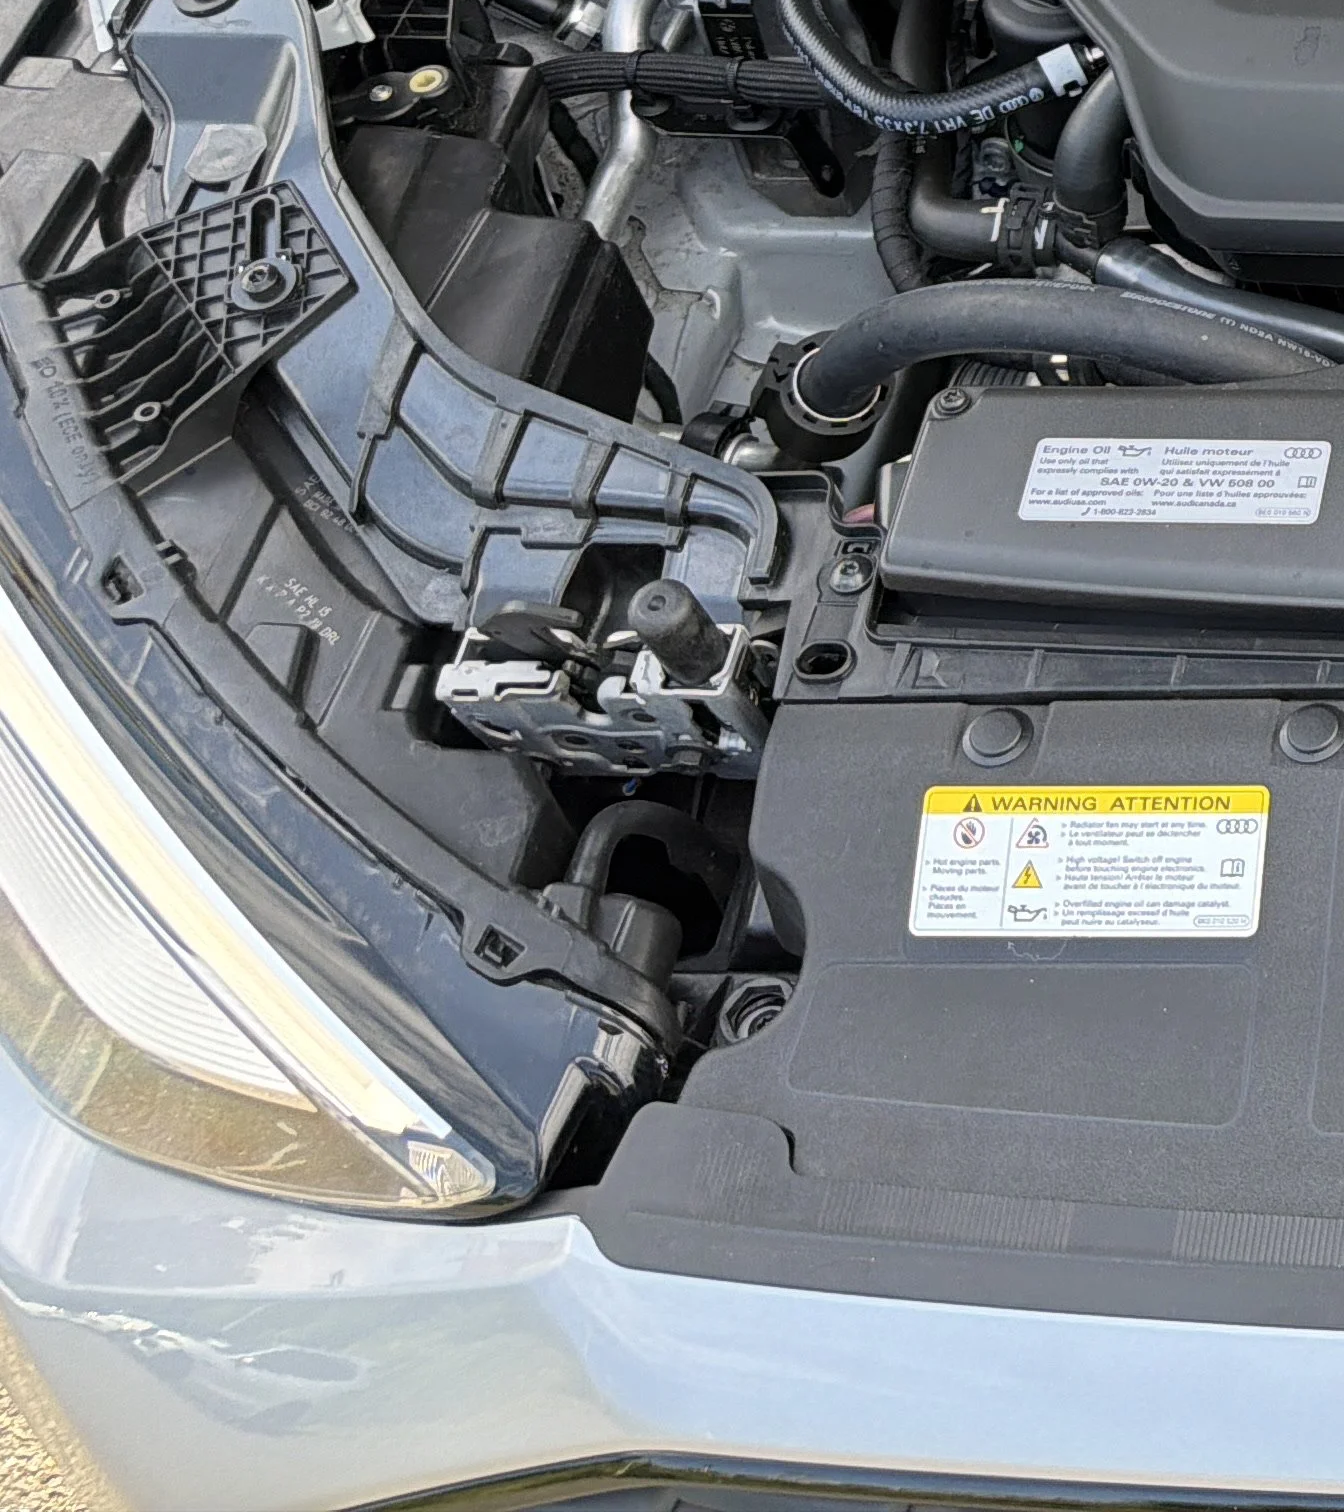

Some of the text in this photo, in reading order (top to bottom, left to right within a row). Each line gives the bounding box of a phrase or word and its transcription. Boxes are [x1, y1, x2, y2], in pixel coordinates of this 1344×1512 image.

[934, 105, 995, 134] DE VRT
[1043, 445, 1111, 456] Engine Oil
[1164, 446, 1253, 456] Huile moteur
[1058, 458, 1076, 466] only
[1196, 459, 1249, 468] uniquement
[1250, 459, 1262, 467] de
[1080, 468, 1118, 476] complies
[1120, 467, 1139, 475] with
[1159, 469, 1175, 477] qui
[1100, 477, 1129, 487] SAE
[1133, 478, 1179, 487] 0W-20
[1182, 478, 1194, 487] &
[1199, 478, 1225, 487] VW
[1257, 479, 1275, 488] 00
[1030, 488, 1045, 496] For
[1055, 488, 1069, 496] list
[1070, 488, 1080, 496] of
[1081, 489, 1124, 498] approved
[1153, 489, 1174, 497] Pour
[1196, 490, 1214, 498] liste
[1151, 499, 1237, 508] www.audicanada.ca
[991, 796, 1231, 811] WARNING ATTENTION
[1125, 830, 1144, 838] peut
[932, 858, 948, 866] Hot
[949, 859, 977, 867] engine
[1066, 856, 1085, 864] High
[1122, 856, 1150, 864] Switch
[1152, 855, 1163, 863] off
[1165, 857, 1193, 865] engine
[932, 866, 963, 876] Moving
[1093, 865, 1129, 874] touching
[1131, 866, 1159, 874] engine
[1062, 899, 1103, 908] Overfilled
[1104, 901, 1132, 909] engine
[1163, 900, 1196, 909] damage
[1062, 909, 1075, 917] Un
[1076, 909, 1126, 918] remplissage
[1127, 909, 1160, 917] excessif
[1061, 918, 1080, 926] peut
[1082, 918, 1103, 926] nuire
